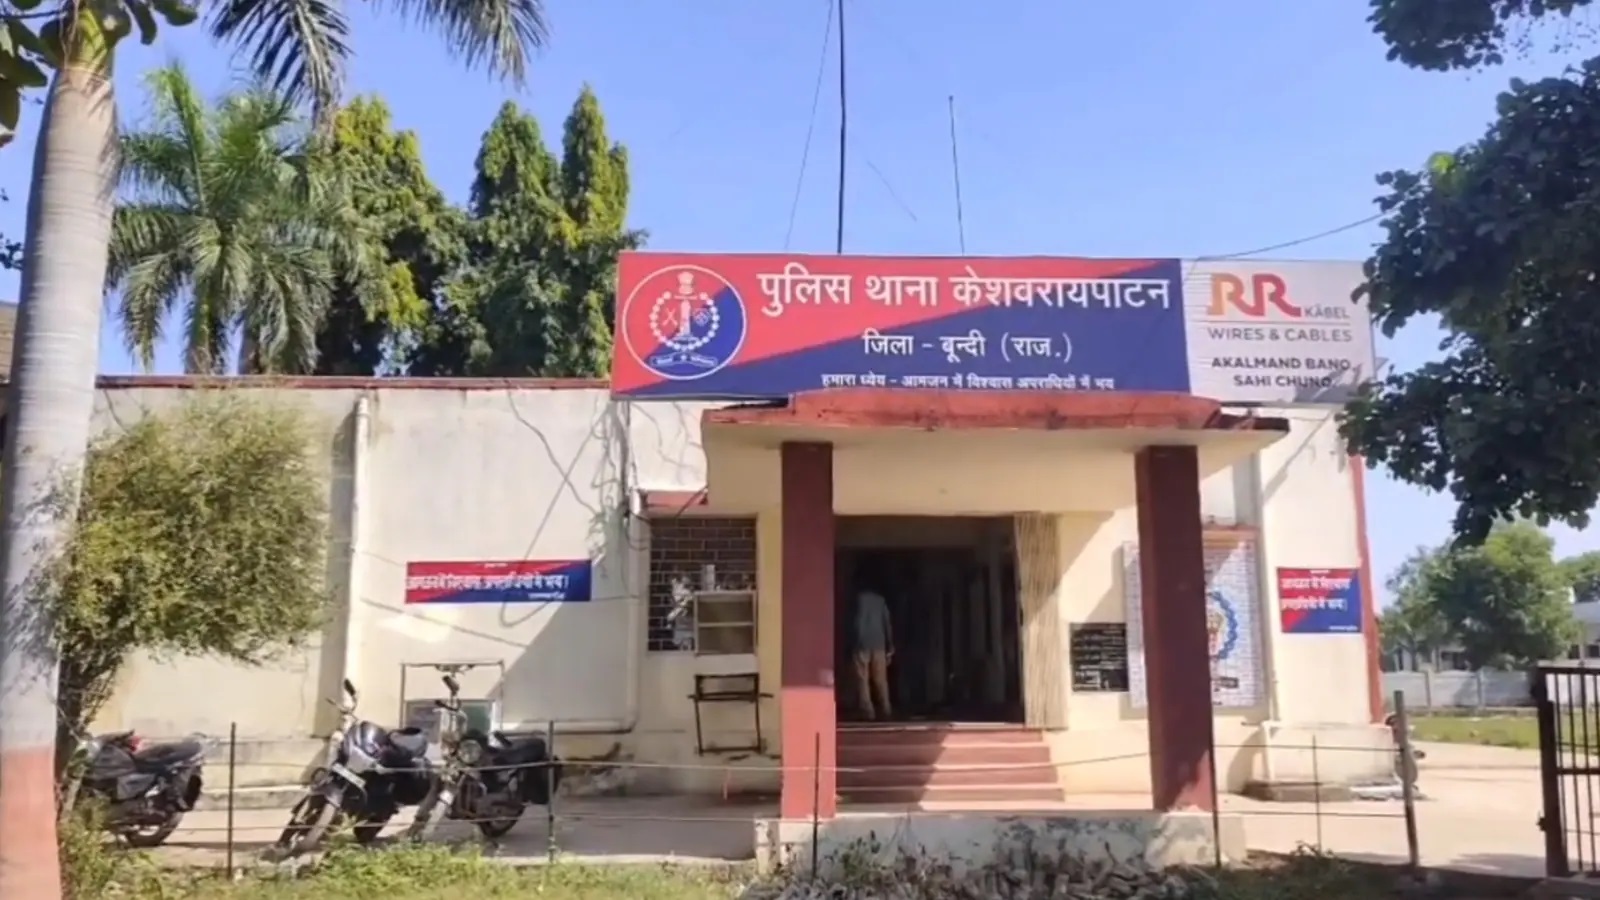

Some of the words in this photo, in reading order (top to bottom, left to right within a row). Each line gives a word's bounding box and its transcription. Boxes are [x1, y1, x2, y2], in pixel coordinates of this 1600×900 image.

[756, 262, 852, 318] पुलिस
[865, 275, 939, 307] थाना
[948, 266, 1170, 309] केशवरायपाटन
[1207, 273, 1302, 318] RR
[1207, 327, 1265, 341] WIRES
[1269, 328, 1281, 341] &
[1284, 328, 1353, 343] CABLES
[862, 329, 914, 354] जिला
[938, 329, 986, 362] बून्दी
[1000, 332, 1073, 363] (राज.)
[1211, 357, 1302, 369] AKALMAND
[821, 373, 856, 388] हमारा
[901, 375, 948, 388] आमजन
[951, 372, 963, 388] में
[1233, 375, 1272, 387] SAHI
